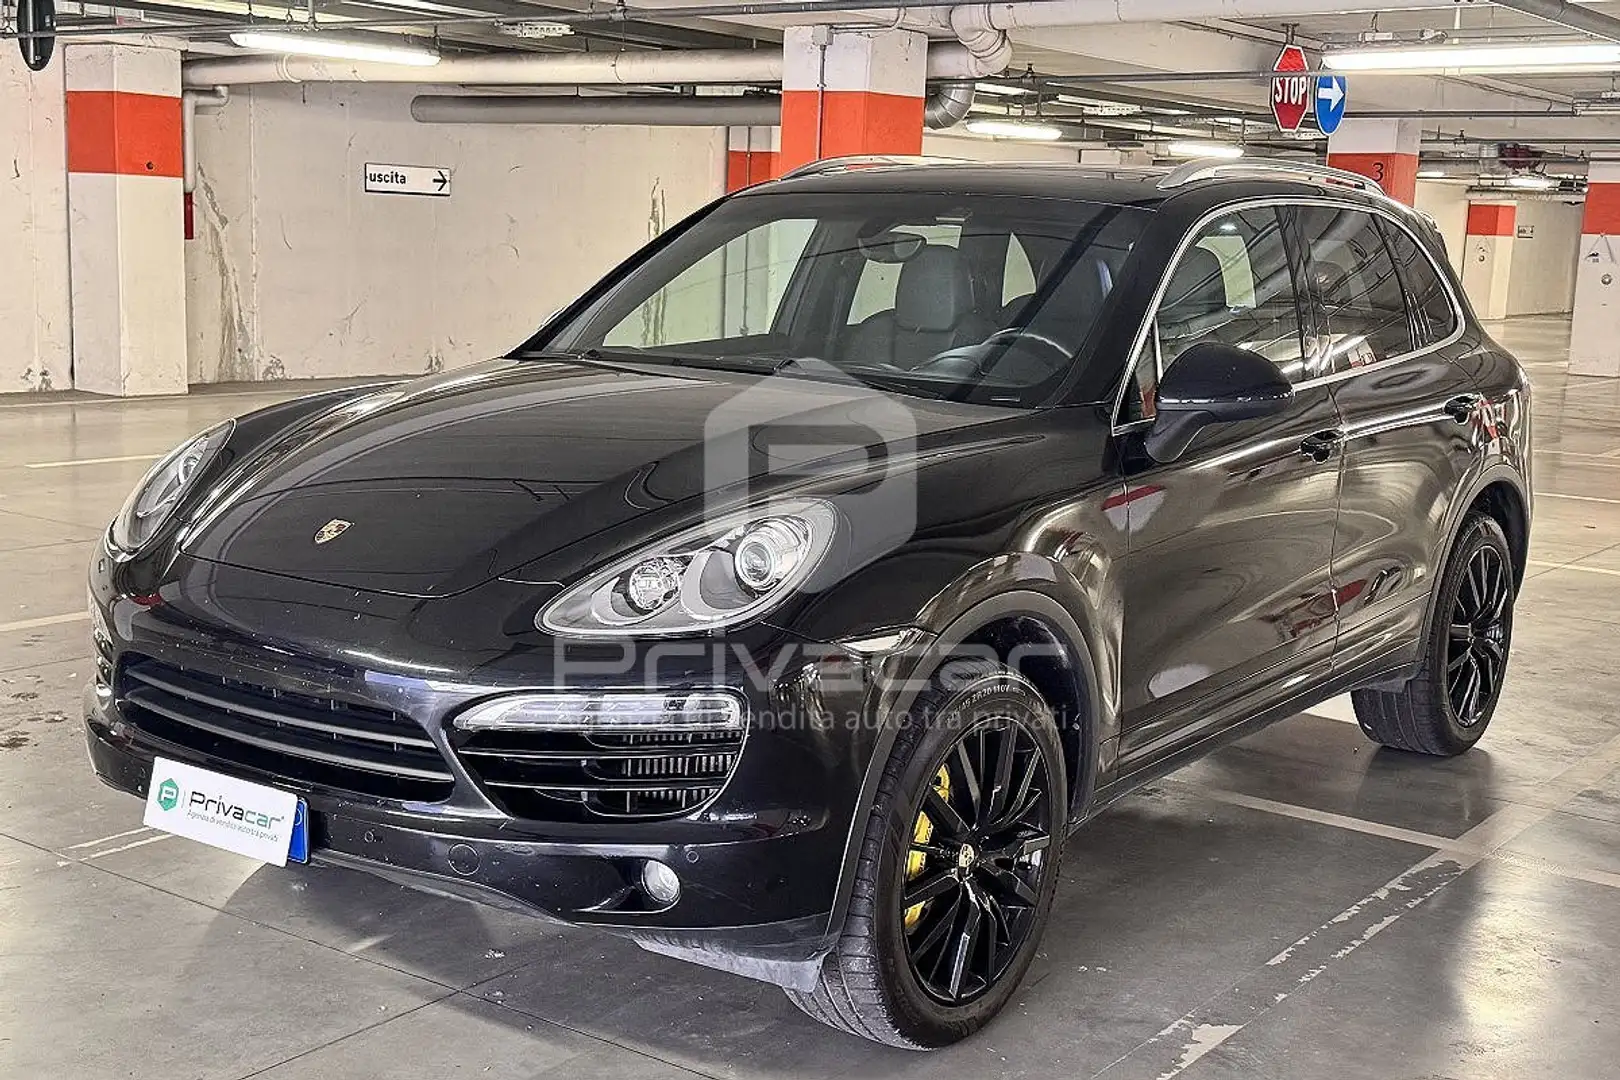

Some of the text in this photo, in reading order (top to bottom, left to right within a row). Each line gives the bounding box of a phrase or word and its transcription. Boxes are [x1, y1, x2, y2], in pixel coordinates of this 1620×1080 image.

[1274, 75, 1307, 105] STOP
[369, 171, 407, 184] uscita
[1372, 162, 1384, 182] 3
